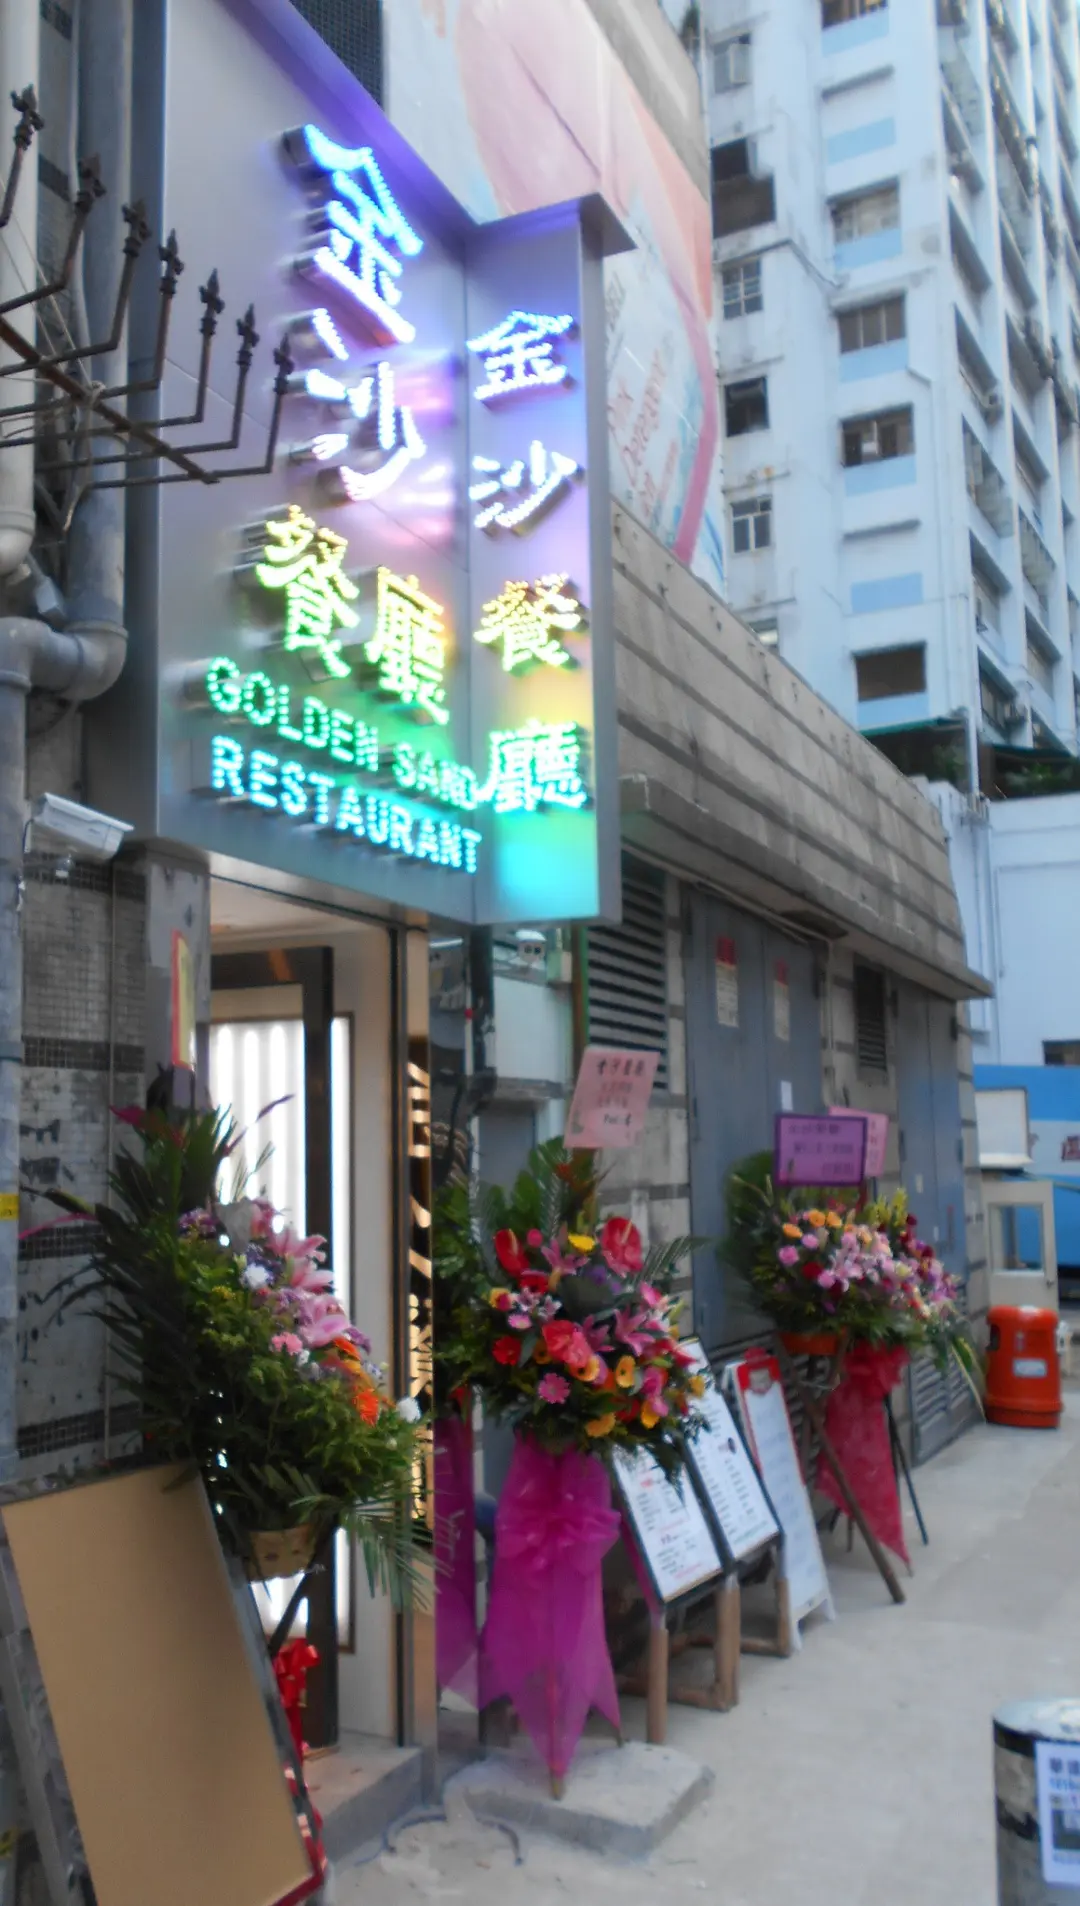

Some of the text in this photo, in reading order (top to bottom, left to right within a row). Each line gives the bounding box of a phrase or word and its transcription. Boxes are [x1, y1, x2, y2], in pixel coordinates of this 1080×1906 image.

[206, 656, 479, 811] GOLDEN SAND
[211, 735, 483, 874] RESTAURANT
